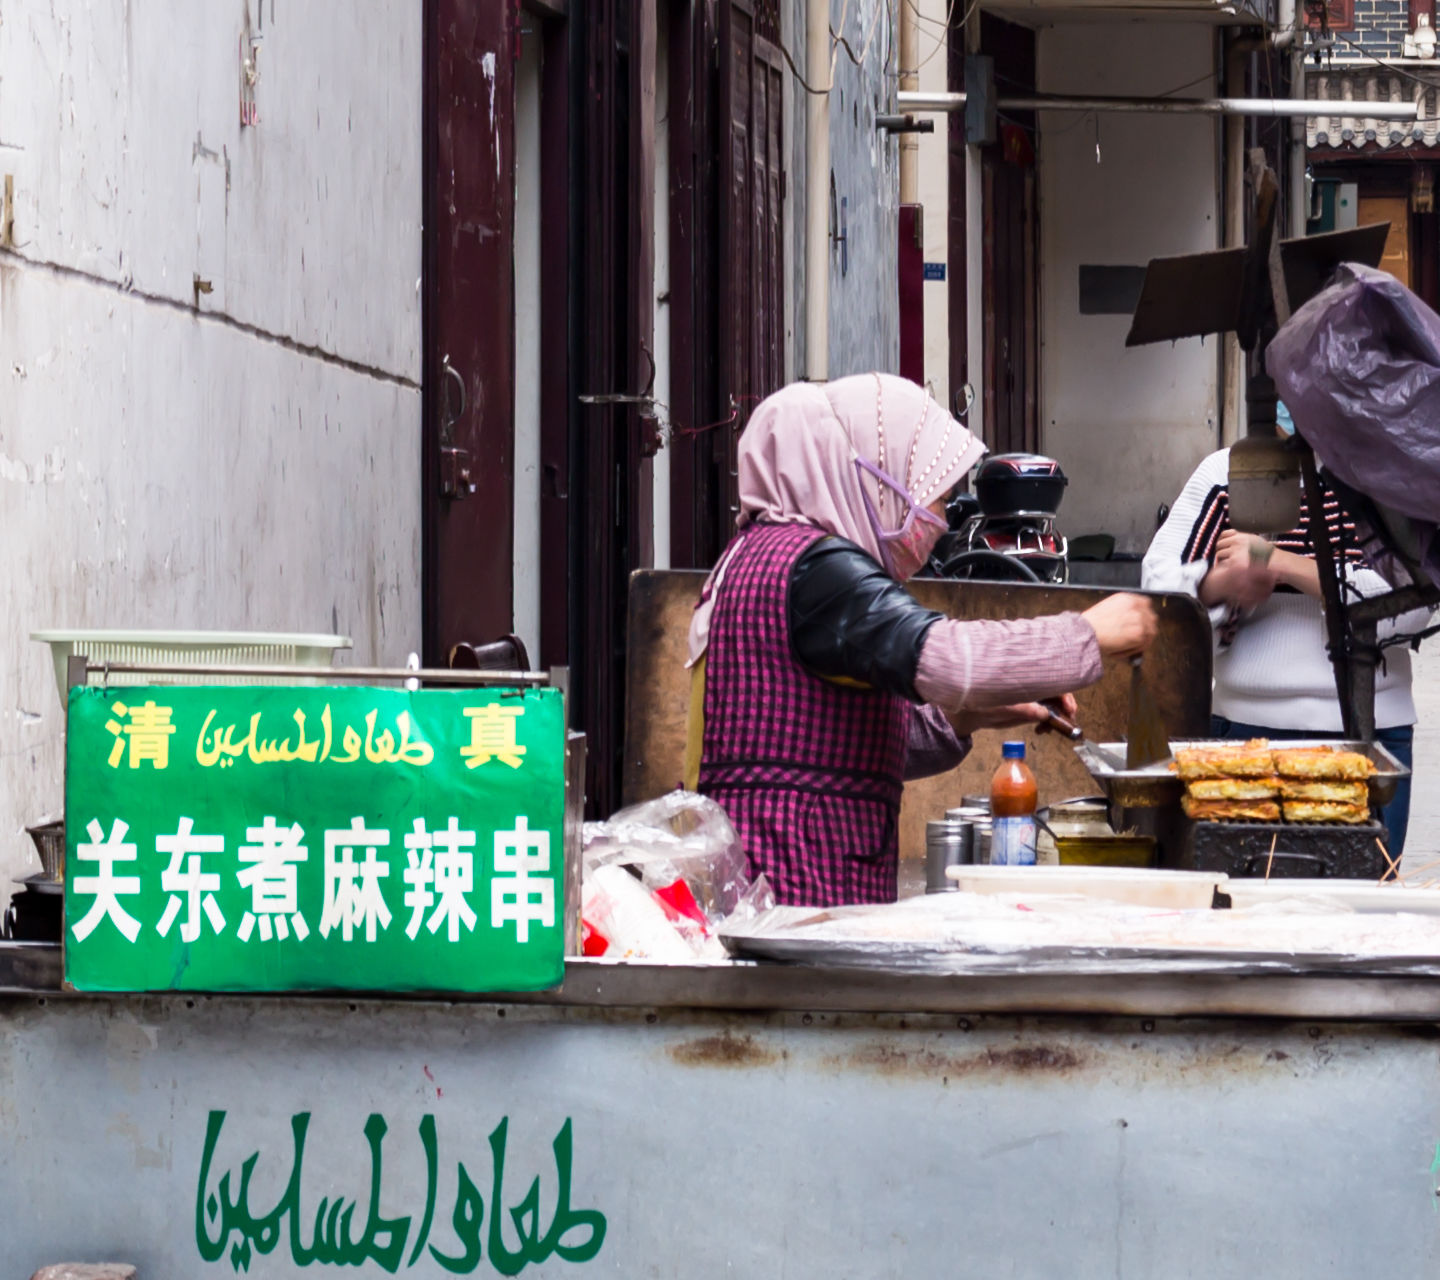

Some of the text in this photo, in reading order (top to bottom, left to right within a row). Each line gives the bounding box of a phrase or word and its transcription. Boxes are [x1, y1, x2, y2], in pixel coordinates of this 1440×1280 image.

[105, 701, 176, 769] 清
[459, 702, 527, 769] 真
[73, 815, 556, 944] 关东煮麻辣串
